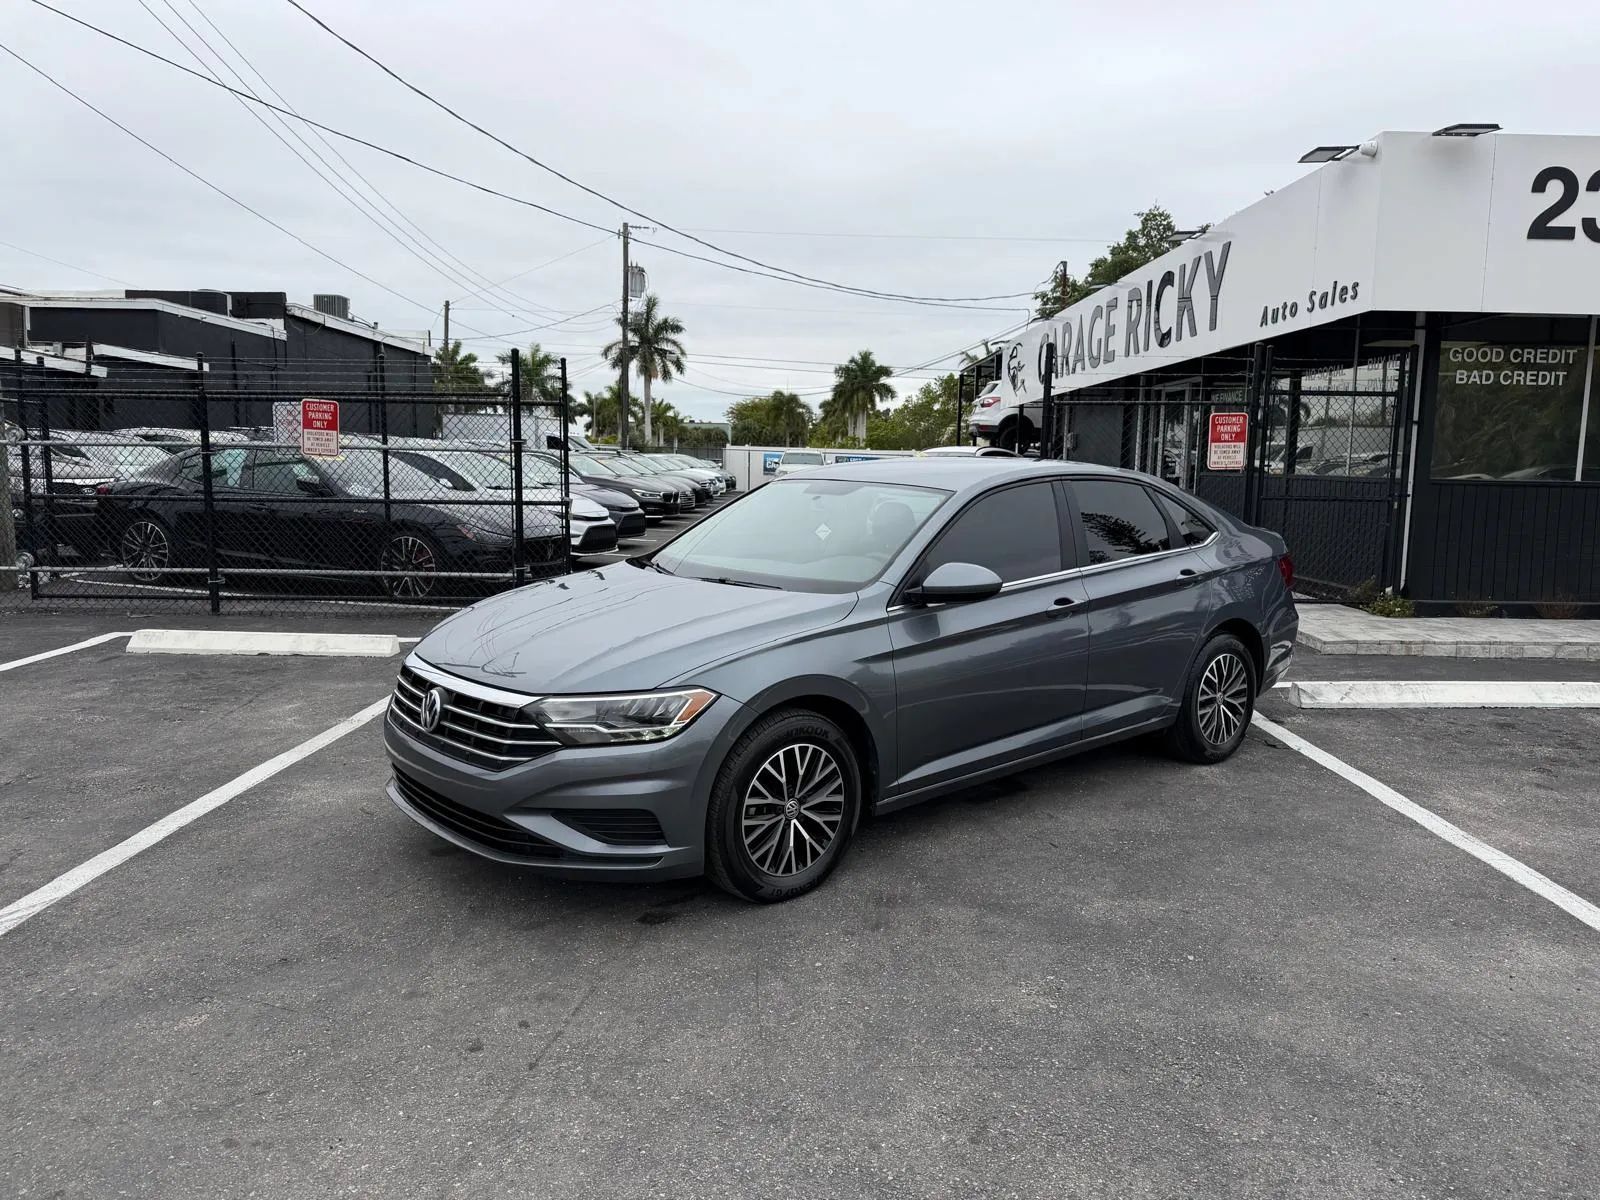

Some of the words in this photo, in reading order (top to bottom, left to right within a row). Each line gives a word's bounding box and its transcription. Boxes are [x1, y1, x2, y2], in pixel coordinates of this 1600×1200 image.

[1124, 240, 1232, 358] RICKY
[1259, 301, 1298, 327] Auto
[1306, 280, 1359, 313] Sales
[1449, 347, 1505, 363] GOOD
[1509, 348, 1577, 364] CREDIT
[1455, 369, 1495, 385] BAD
[1499, 370, 1567, 386] CREDIT
[305, 402, 335, 412] CUSTOMER
[308, 411, 333, 420] PARKING
[1214, 416, 1244, 424] CUSTOMER
[312, 420, 328, 429] ONLY
[1216, 424, 1241, 433] PARKING
[1220, 433, 1236, 441] ONLY
